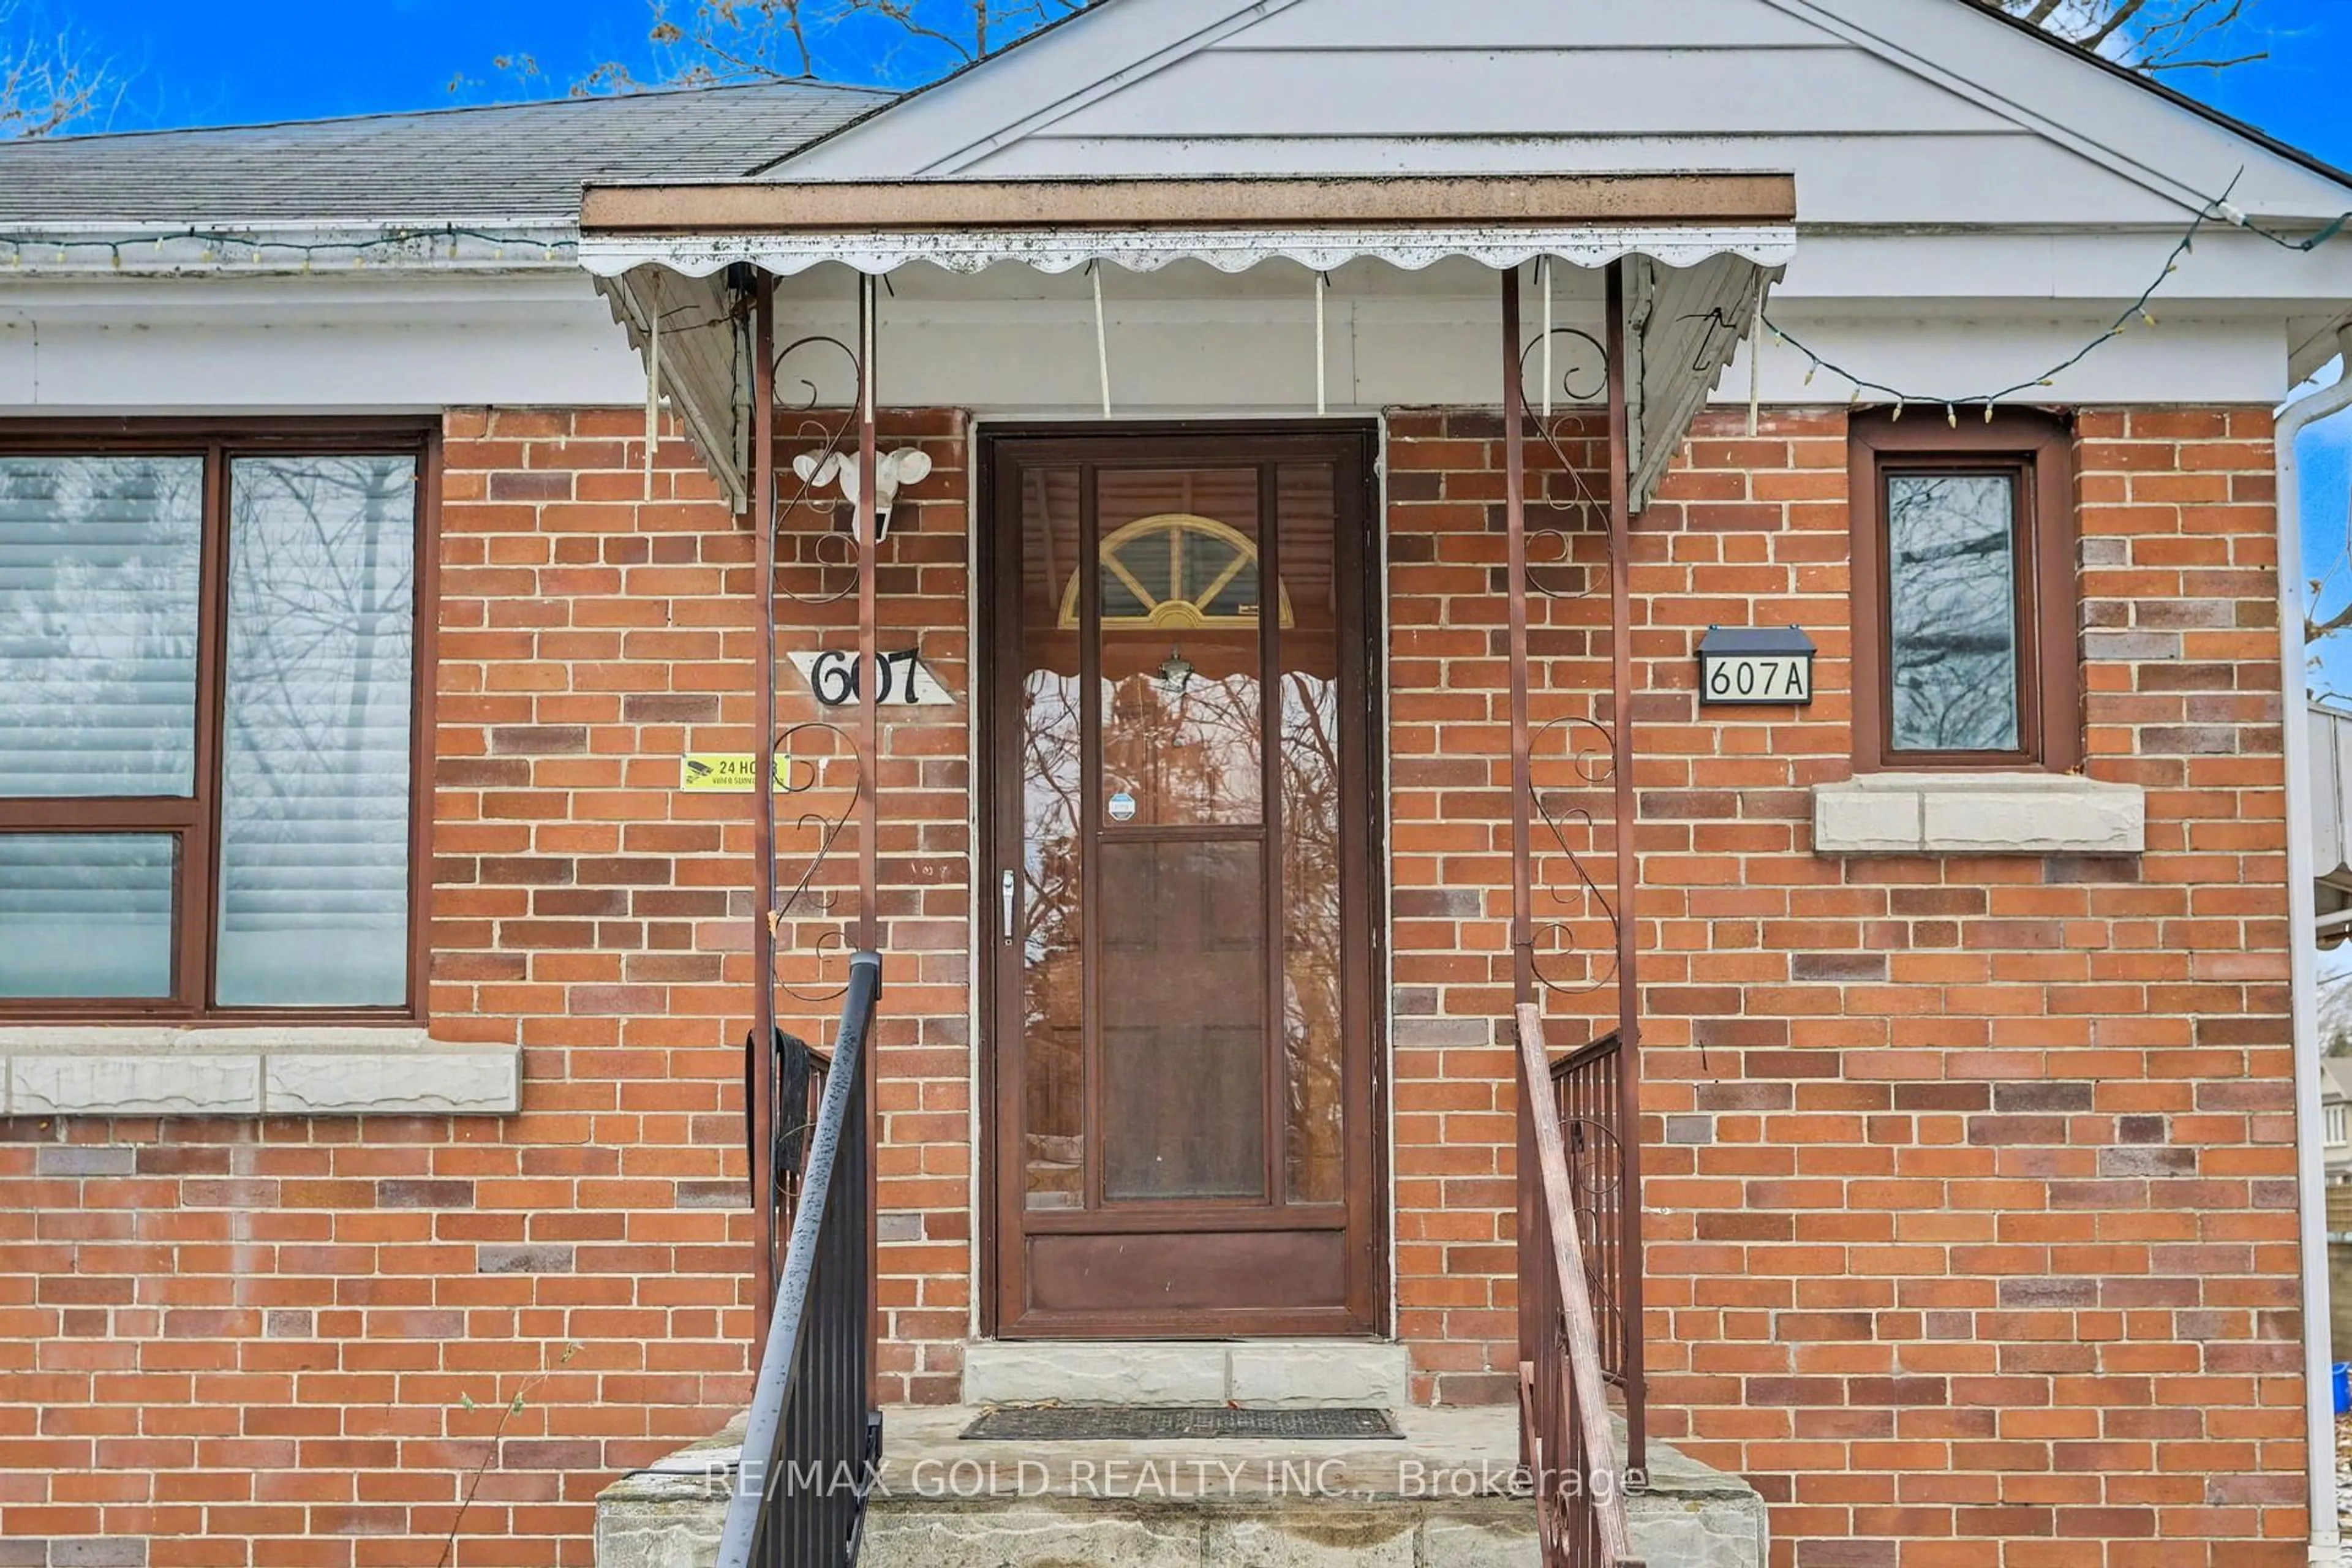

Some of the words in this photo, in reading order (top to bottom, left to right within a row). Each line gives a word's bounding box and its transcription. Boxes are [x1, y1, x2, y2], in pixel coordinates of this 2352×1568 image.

[811, 647, 920, 706] 607
[1711, 661, 1803, 695] 607A
[720, 761, 735, 774] 24
